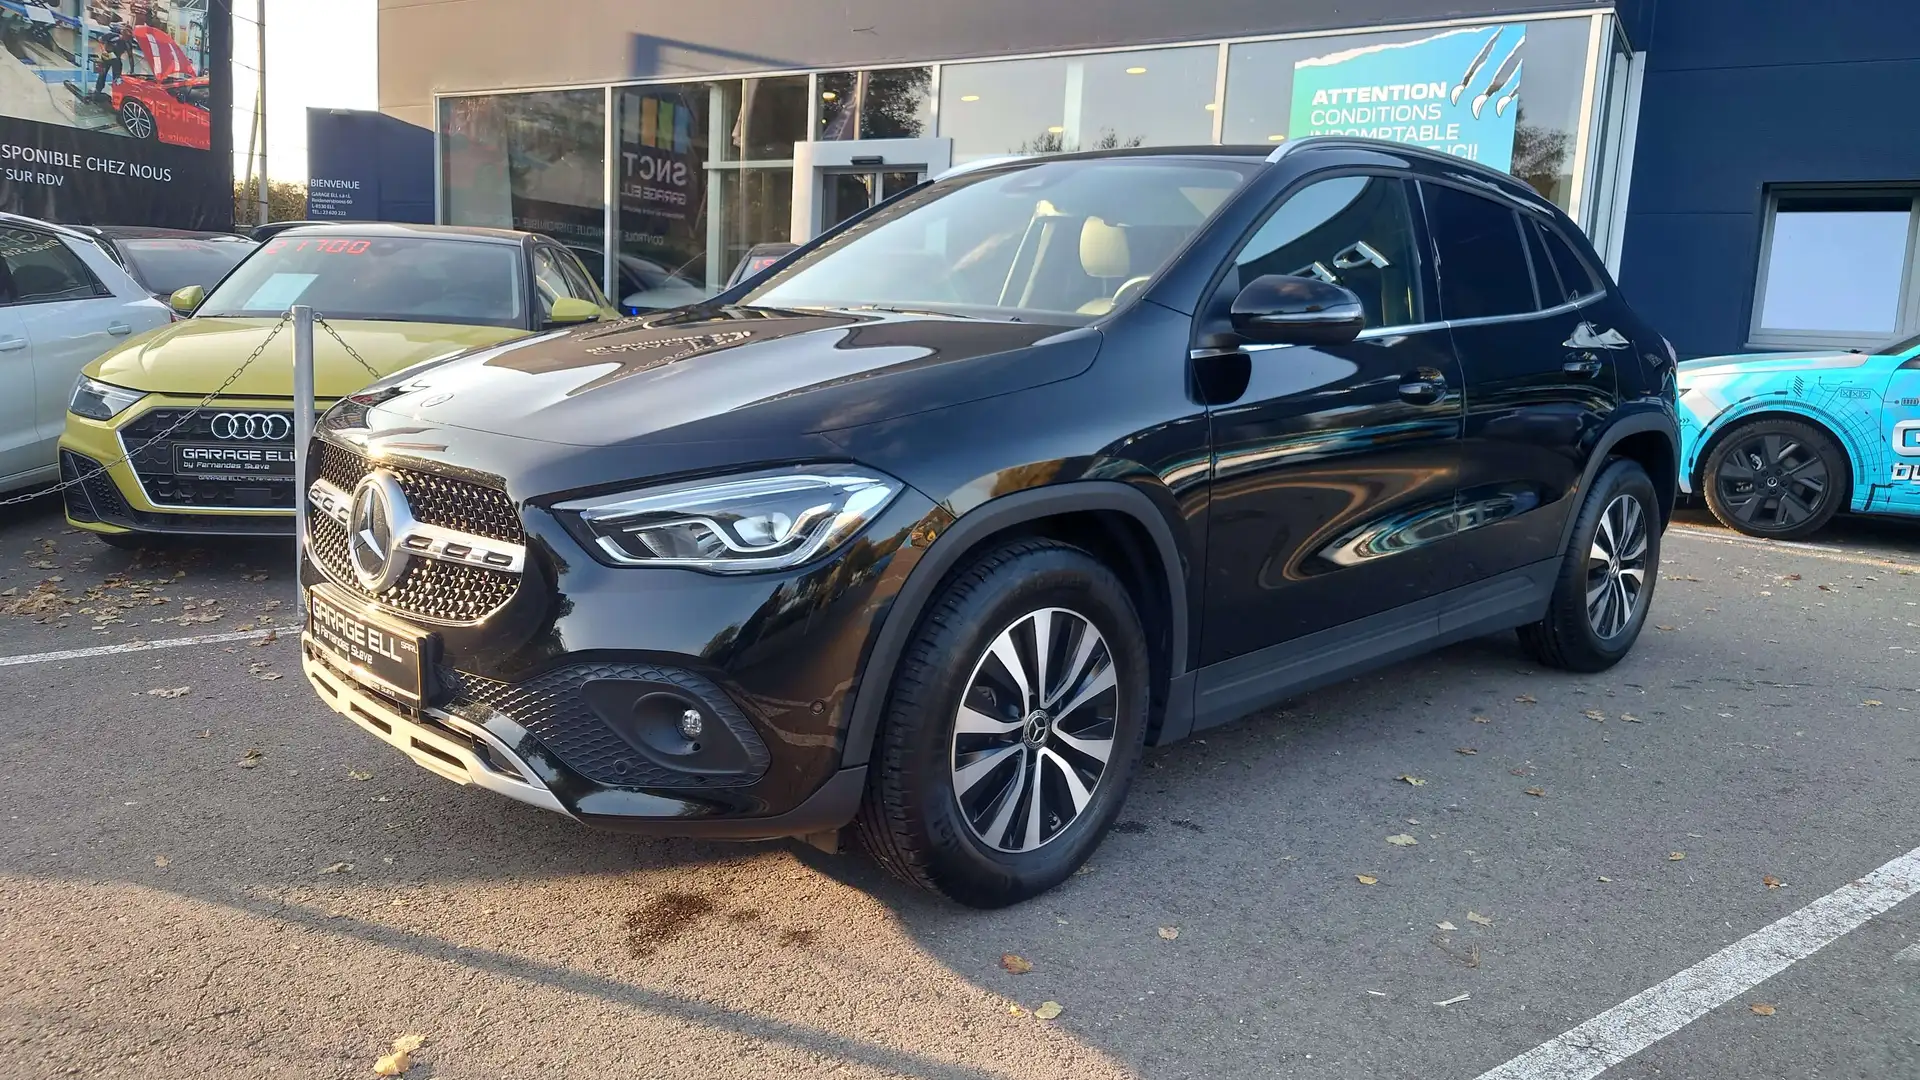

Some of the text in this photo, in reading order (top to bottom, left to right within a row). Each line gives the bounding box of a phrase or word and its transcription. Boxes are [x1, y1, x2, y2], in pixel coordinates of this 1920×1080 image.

[1312, 81, 1447, 106] ATTENTION
[1310, 104, 1442, 126] CONDITIONS
[5, 168, 64, 187] SUR RDV
[86, 157, 125, 175] CHEZ
[129, 163, 172, 182] NOUS
[311, 179, 360, 189] BIENVENUE
[183, 448, 261, 460] GARAGE
[183, 461, 270, 470] by Fernandes Steve
[312, 596, 365, 647] GARAGE
[367, 627, 403, 663] ELL
[313, 619, 373, 665] by Fernandes Steve
